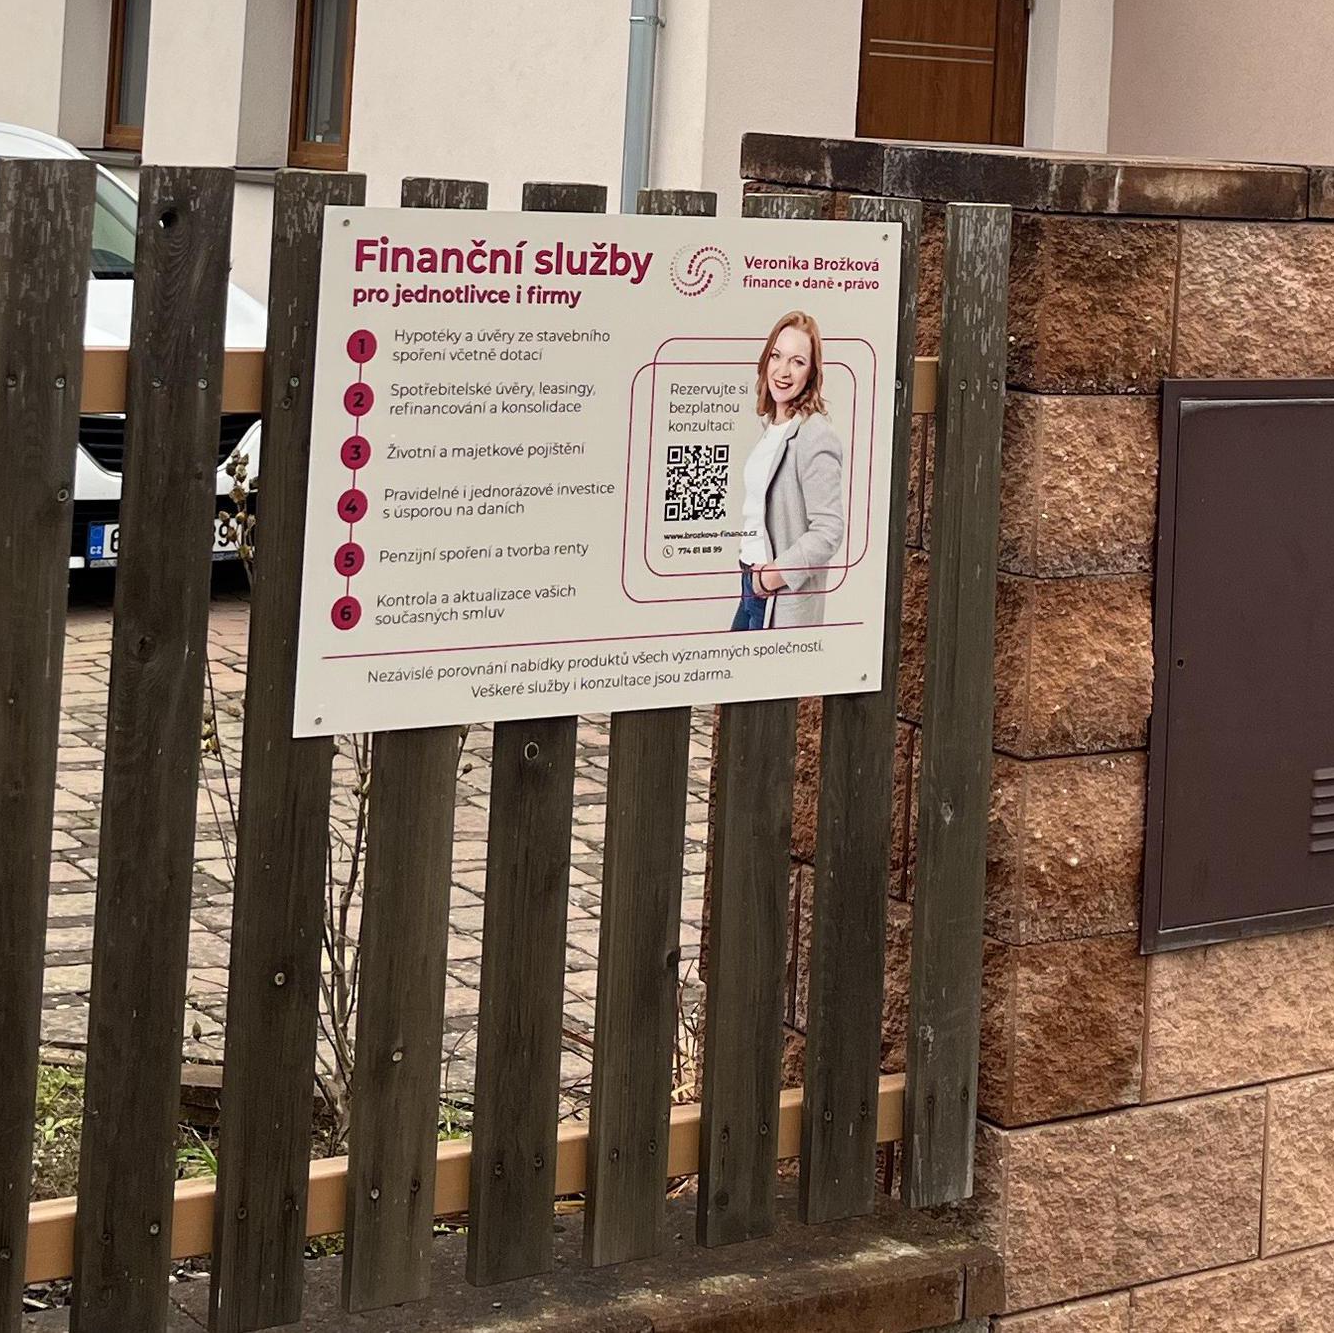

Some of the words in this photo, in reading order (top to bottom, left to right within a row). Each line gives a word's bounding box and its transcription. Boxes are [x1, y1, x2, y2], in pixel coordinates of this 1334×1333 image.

[355, 236, 528, 274] Finanční
[534, 241, 653, 284] služby
[744, 256, 809, 270] Veronika
[814, 257, 879, 272] Brožková
[743, 276, 792, 288] finance
[803, 276, 834, 289] daně
[844, 277, 879, 292] právo
[353, 286, 389, 306] pro
[392, 284, 510, 307] jednotlivce
[516, 285, 522, 303] i
[527, 286, 581, 308] firmy
[394, 329, 462, 345] Hypotéky
[465, 333, 473, 341] a
[478, 330, 514, 345] úvěry
[518, 333, 533, 341] ze
[537, 329, 610, 342] stavebního
[358, 338, 365, 354] 1
[393, 348, 445, 364] spoření
[449, 348, 496, 361] včetně
[499, 350, 543, 361] dotací
[390, 382, 492, 398] Spotřebitelské
[496, 382, 535, 397] úvěry,
[539, 382, 596, 397] leasingy,
[670, 383, 736, 398] Rezervujte
[739, 383, 748, 394] si
[353, 392, 364, 407] 2
[389, 401, 486, 415] refinancování
[490, 404, 497, 413] a
[501, 401, 582, 413] konsolidace
[669, 402, 739, 415] bezplatnou
[350, 445, 361, 460] 3
[387, 443, 436, 459] Životní
[440, 448, 448, 458] a
[451, 443, 524, 460] majetkové
[528, 442, 585, 459] pojištění
[384, 486, 459, 501] Pravidelné
[463, 486, 467, 498] i
[468, 484, 553, 502] jednorázové
[557, 482, 615, 495] investice
[345, 499, 357, 514] 4
[383, 508, 389, 519] s
[393, 505, 452, 521] úsporou
[456, 506, 473, 516] na
[478, 502, 525, 514] daních
[90, 546, 102, 554] CZ
[379, 547, 436, 565] Penzijní
[439, 547, 492, 562] spoření
[495, 547, 503, 558] a
[507, 544, 550, 557] tvorba
[554, 543, 589, 557] renty
[344, 552, 355, 567] 5
[377, 591, 437, 608] Kontrola
[441, 594, 449, 604] a
[453, 588, 531, 604] aktualizace
[534, 585, 576, 599] vašich
[341, 606, 352, 621] 6
[375, 609, 458, 626] současných
[462, 607, 505, 620] smluv
[367, 663, 434, 683] Nezávislé
[437, 660, 507, 681] porovnání
[510, 659, 565, 675] nabídky
[568, 652, 629, 671] produktů
[632, 649, 668, 664] všech
[672, 645, 750, 663] významných
[472, 682, 525, 699] Veškeré
[527, 679, 570, 695] služby
[573, 678, 577, 691] i
[581, 674, 651, 690] konzultace
[653, 673, 681, 687] jsou
[683, 668, 733, 683] zdarma.
